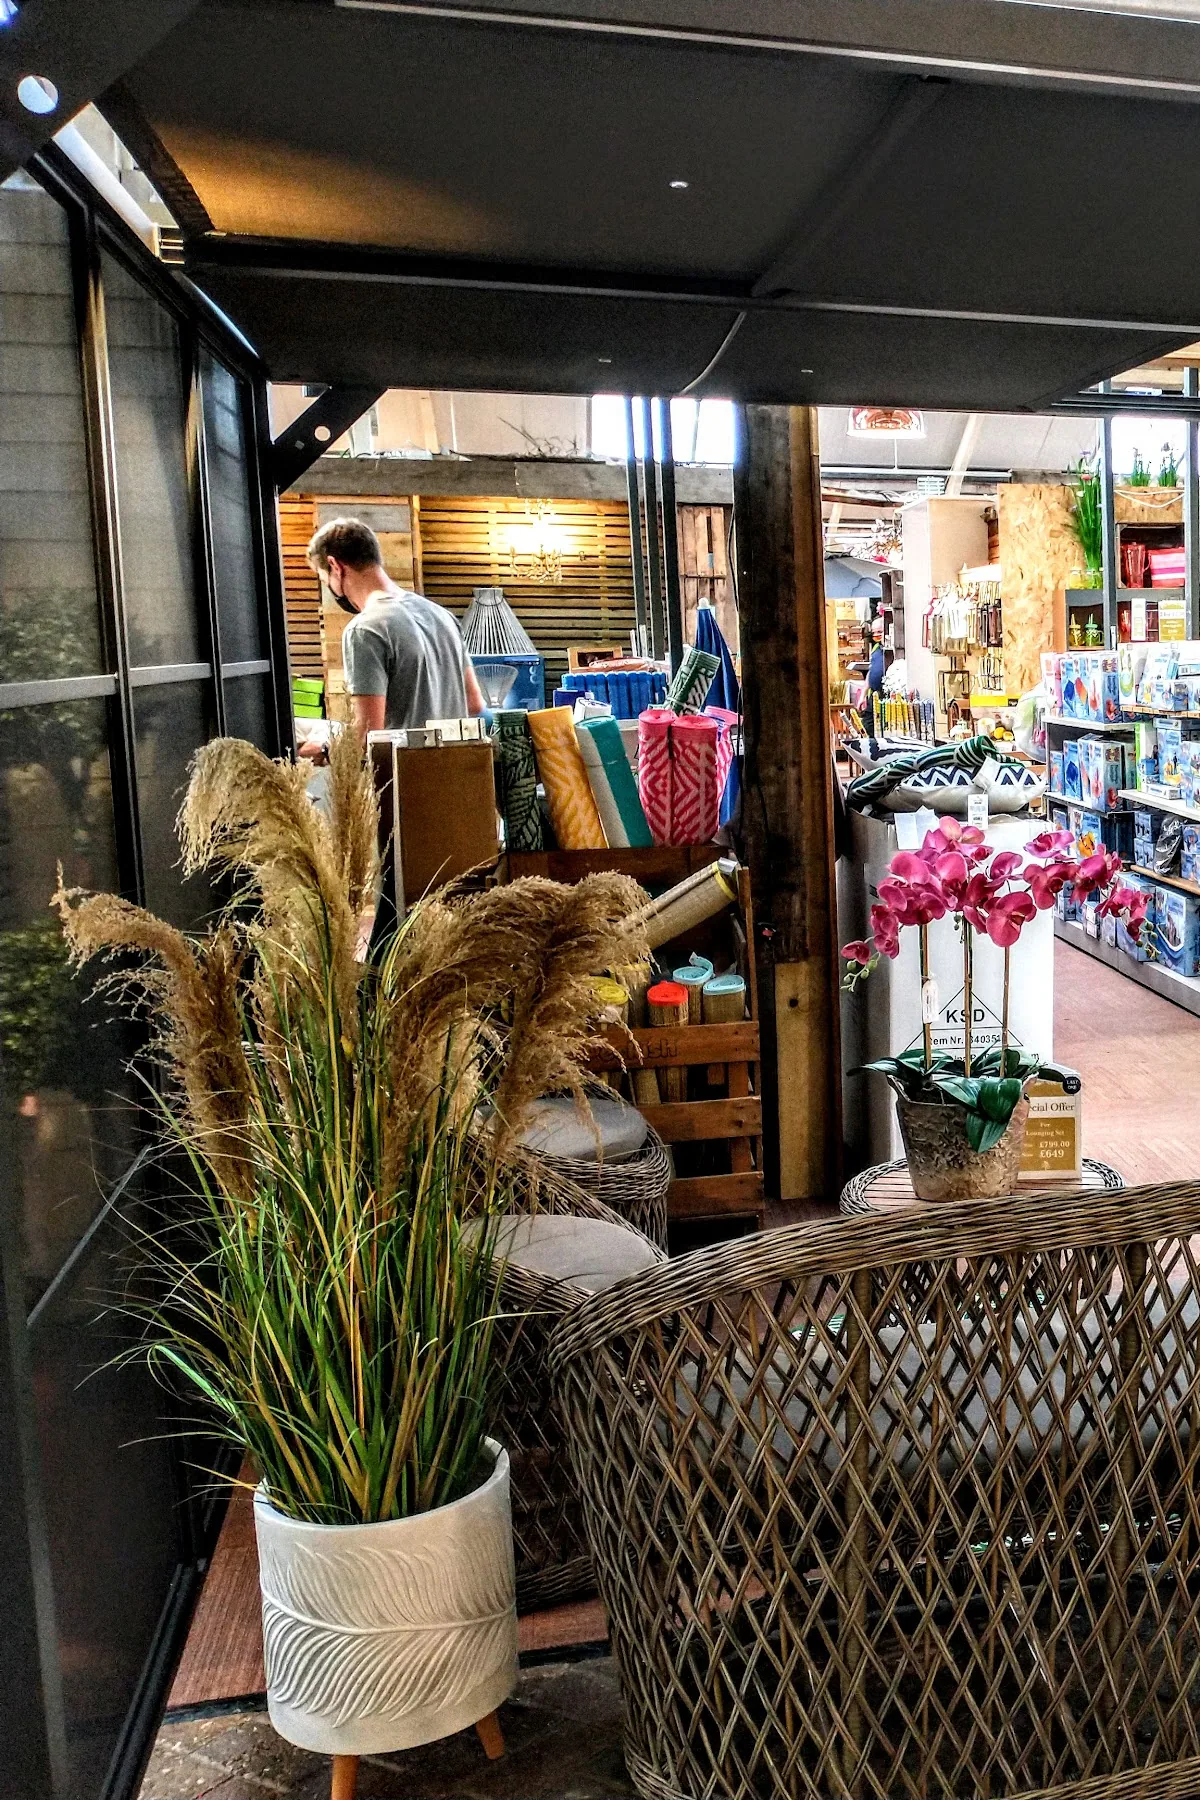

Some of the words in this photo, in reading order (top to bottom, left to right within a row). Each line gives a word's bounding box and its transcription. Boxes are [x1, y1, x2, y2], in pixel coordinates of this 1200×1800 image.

[930, 1037, 948, 1046] tem
[950, 1036, 963, 1045] Nr.
[1029, 1102, 1048, 1112] cial
[1050, 1102, 1075, 1111] Offer
[1040, 1149, 1065, 1158] £649
